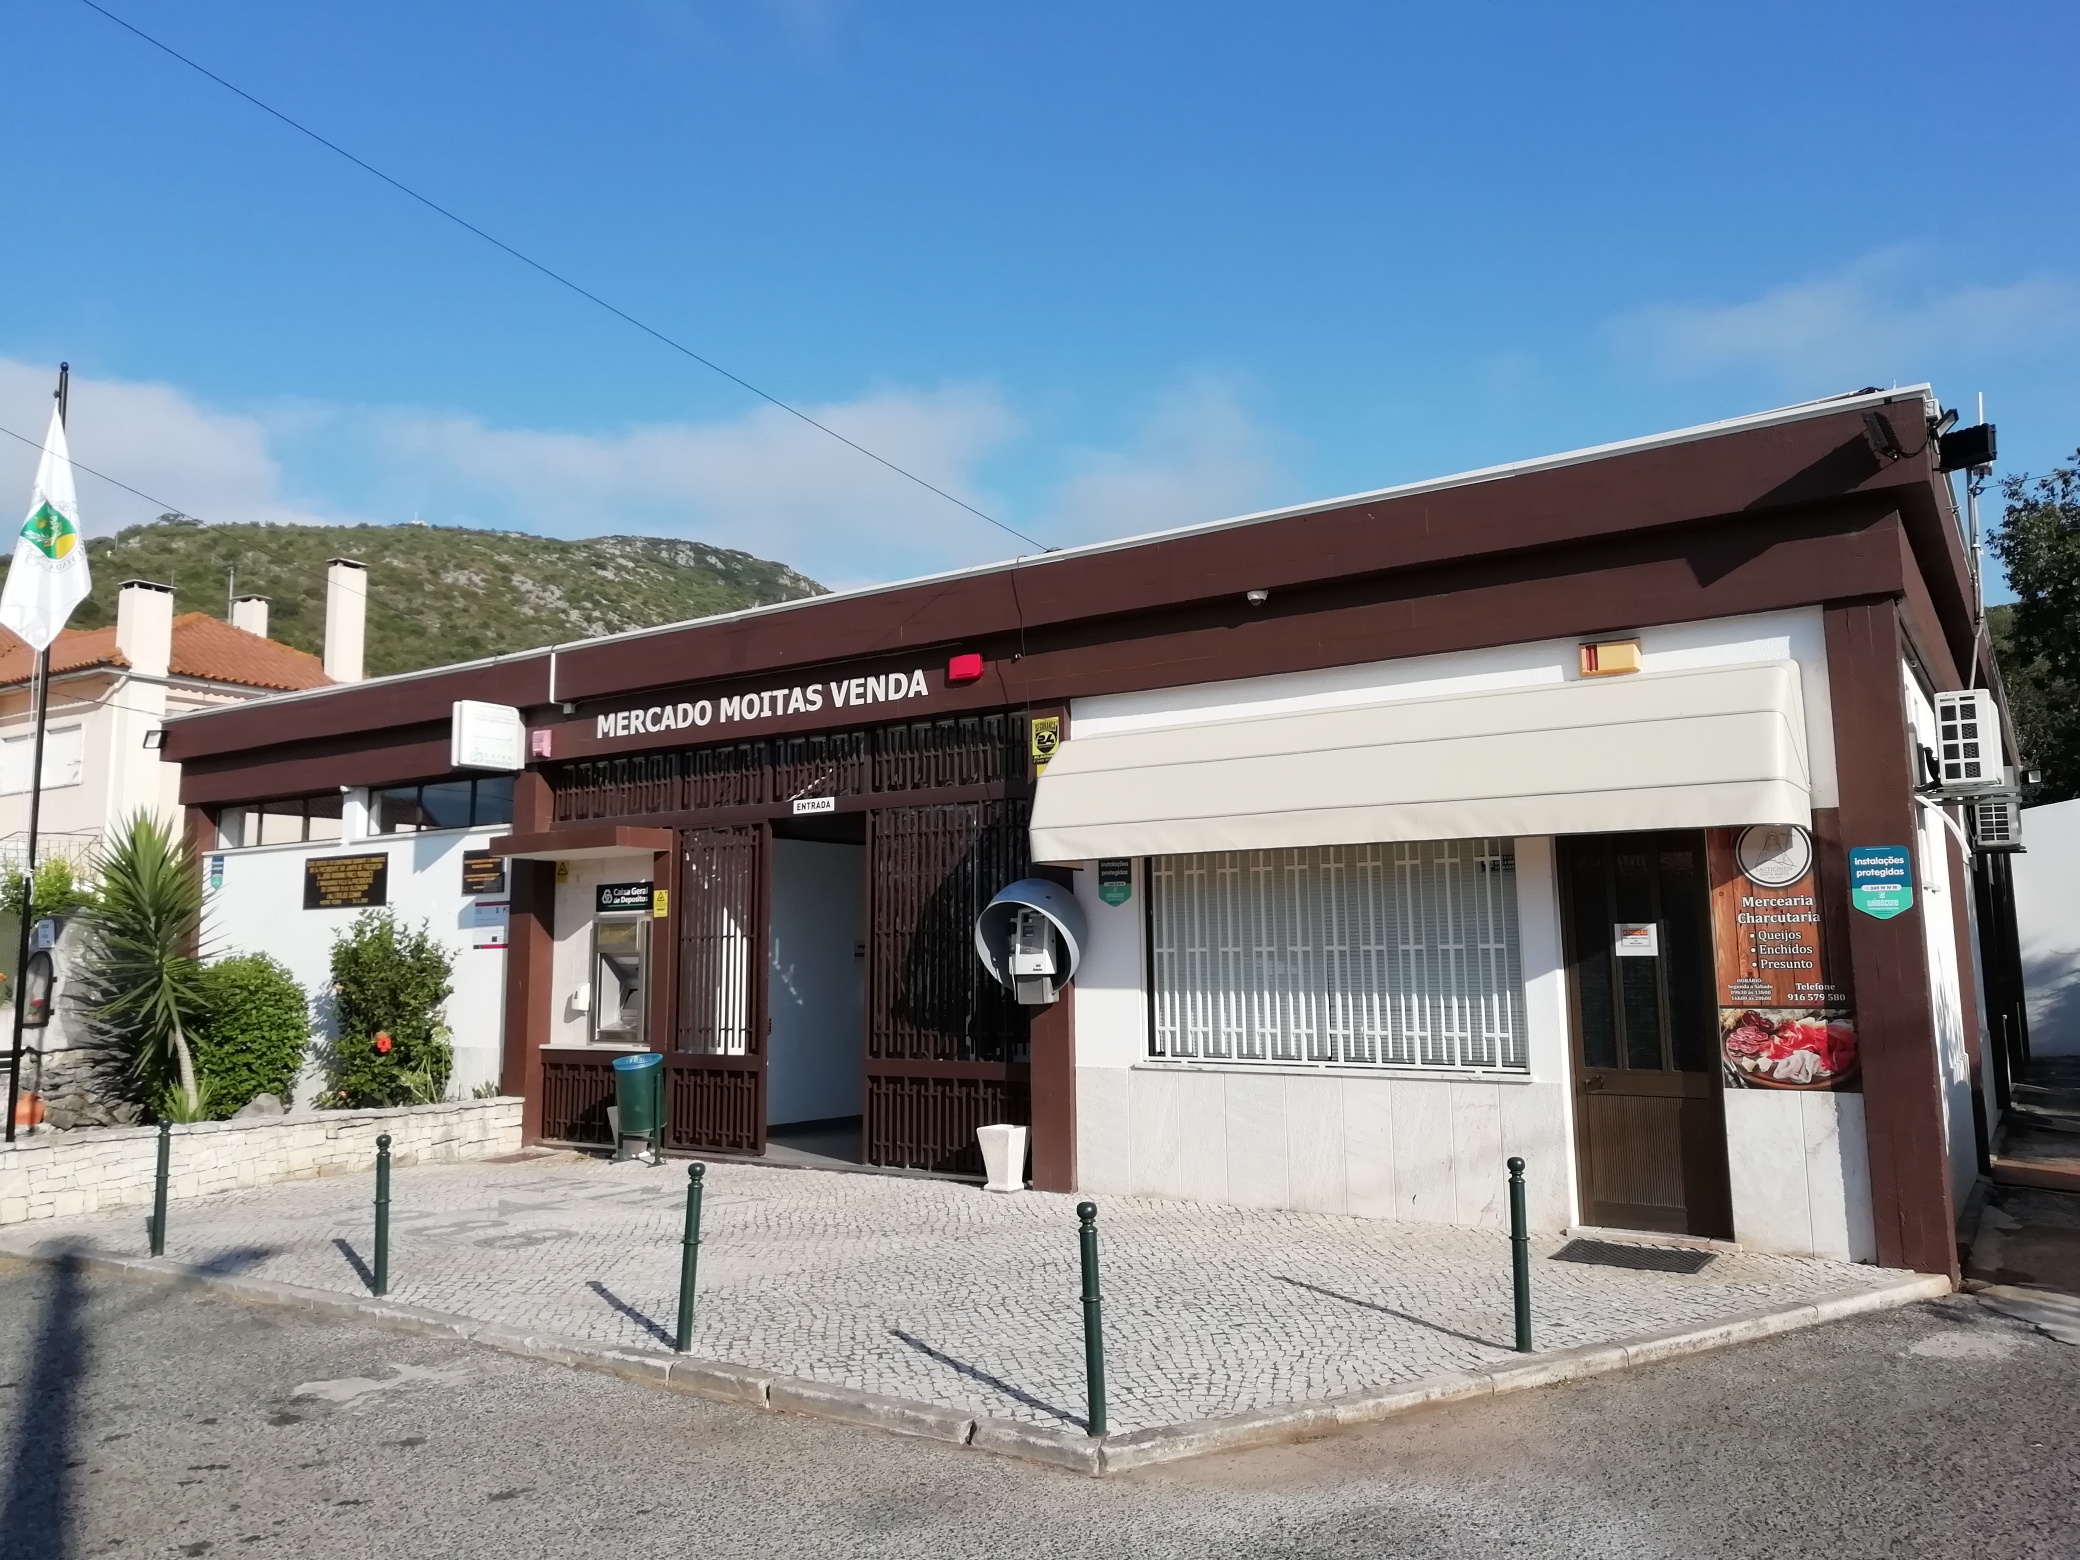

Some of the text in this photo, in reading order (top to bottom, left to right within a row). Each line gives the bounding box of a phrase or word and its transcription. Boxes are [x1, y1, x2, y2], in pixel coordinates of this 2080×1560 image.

[596, 669, 929, 739] MERCADO MOITAS VENDA
[1037, 733, 1055, 745] 24
[796, 799, 831, 812] ENTRADA
[1101, 860, 1129, 868] instalações
[1854, 856, 1904, 866] instalações
[1101, 869, 1129, 877] protegidas
[1856, 868, 1904, 878] protegidas
[631, 887, 648, 895] Geral
[1742, 895, 1814, 907] Mercearia
[1737, 911, 1821, 924] Charcutaria
[1758, 930, 1802, 941] Queijos
[1759, 944, 1813, 955] Enchidos
[1760, 959, 1813, 969] Presunto
[1795, 982, 1836, 991] Telefone
[1807, 993, 1825, 1001] 579
[1827, 993, 1846, 1001] 580
